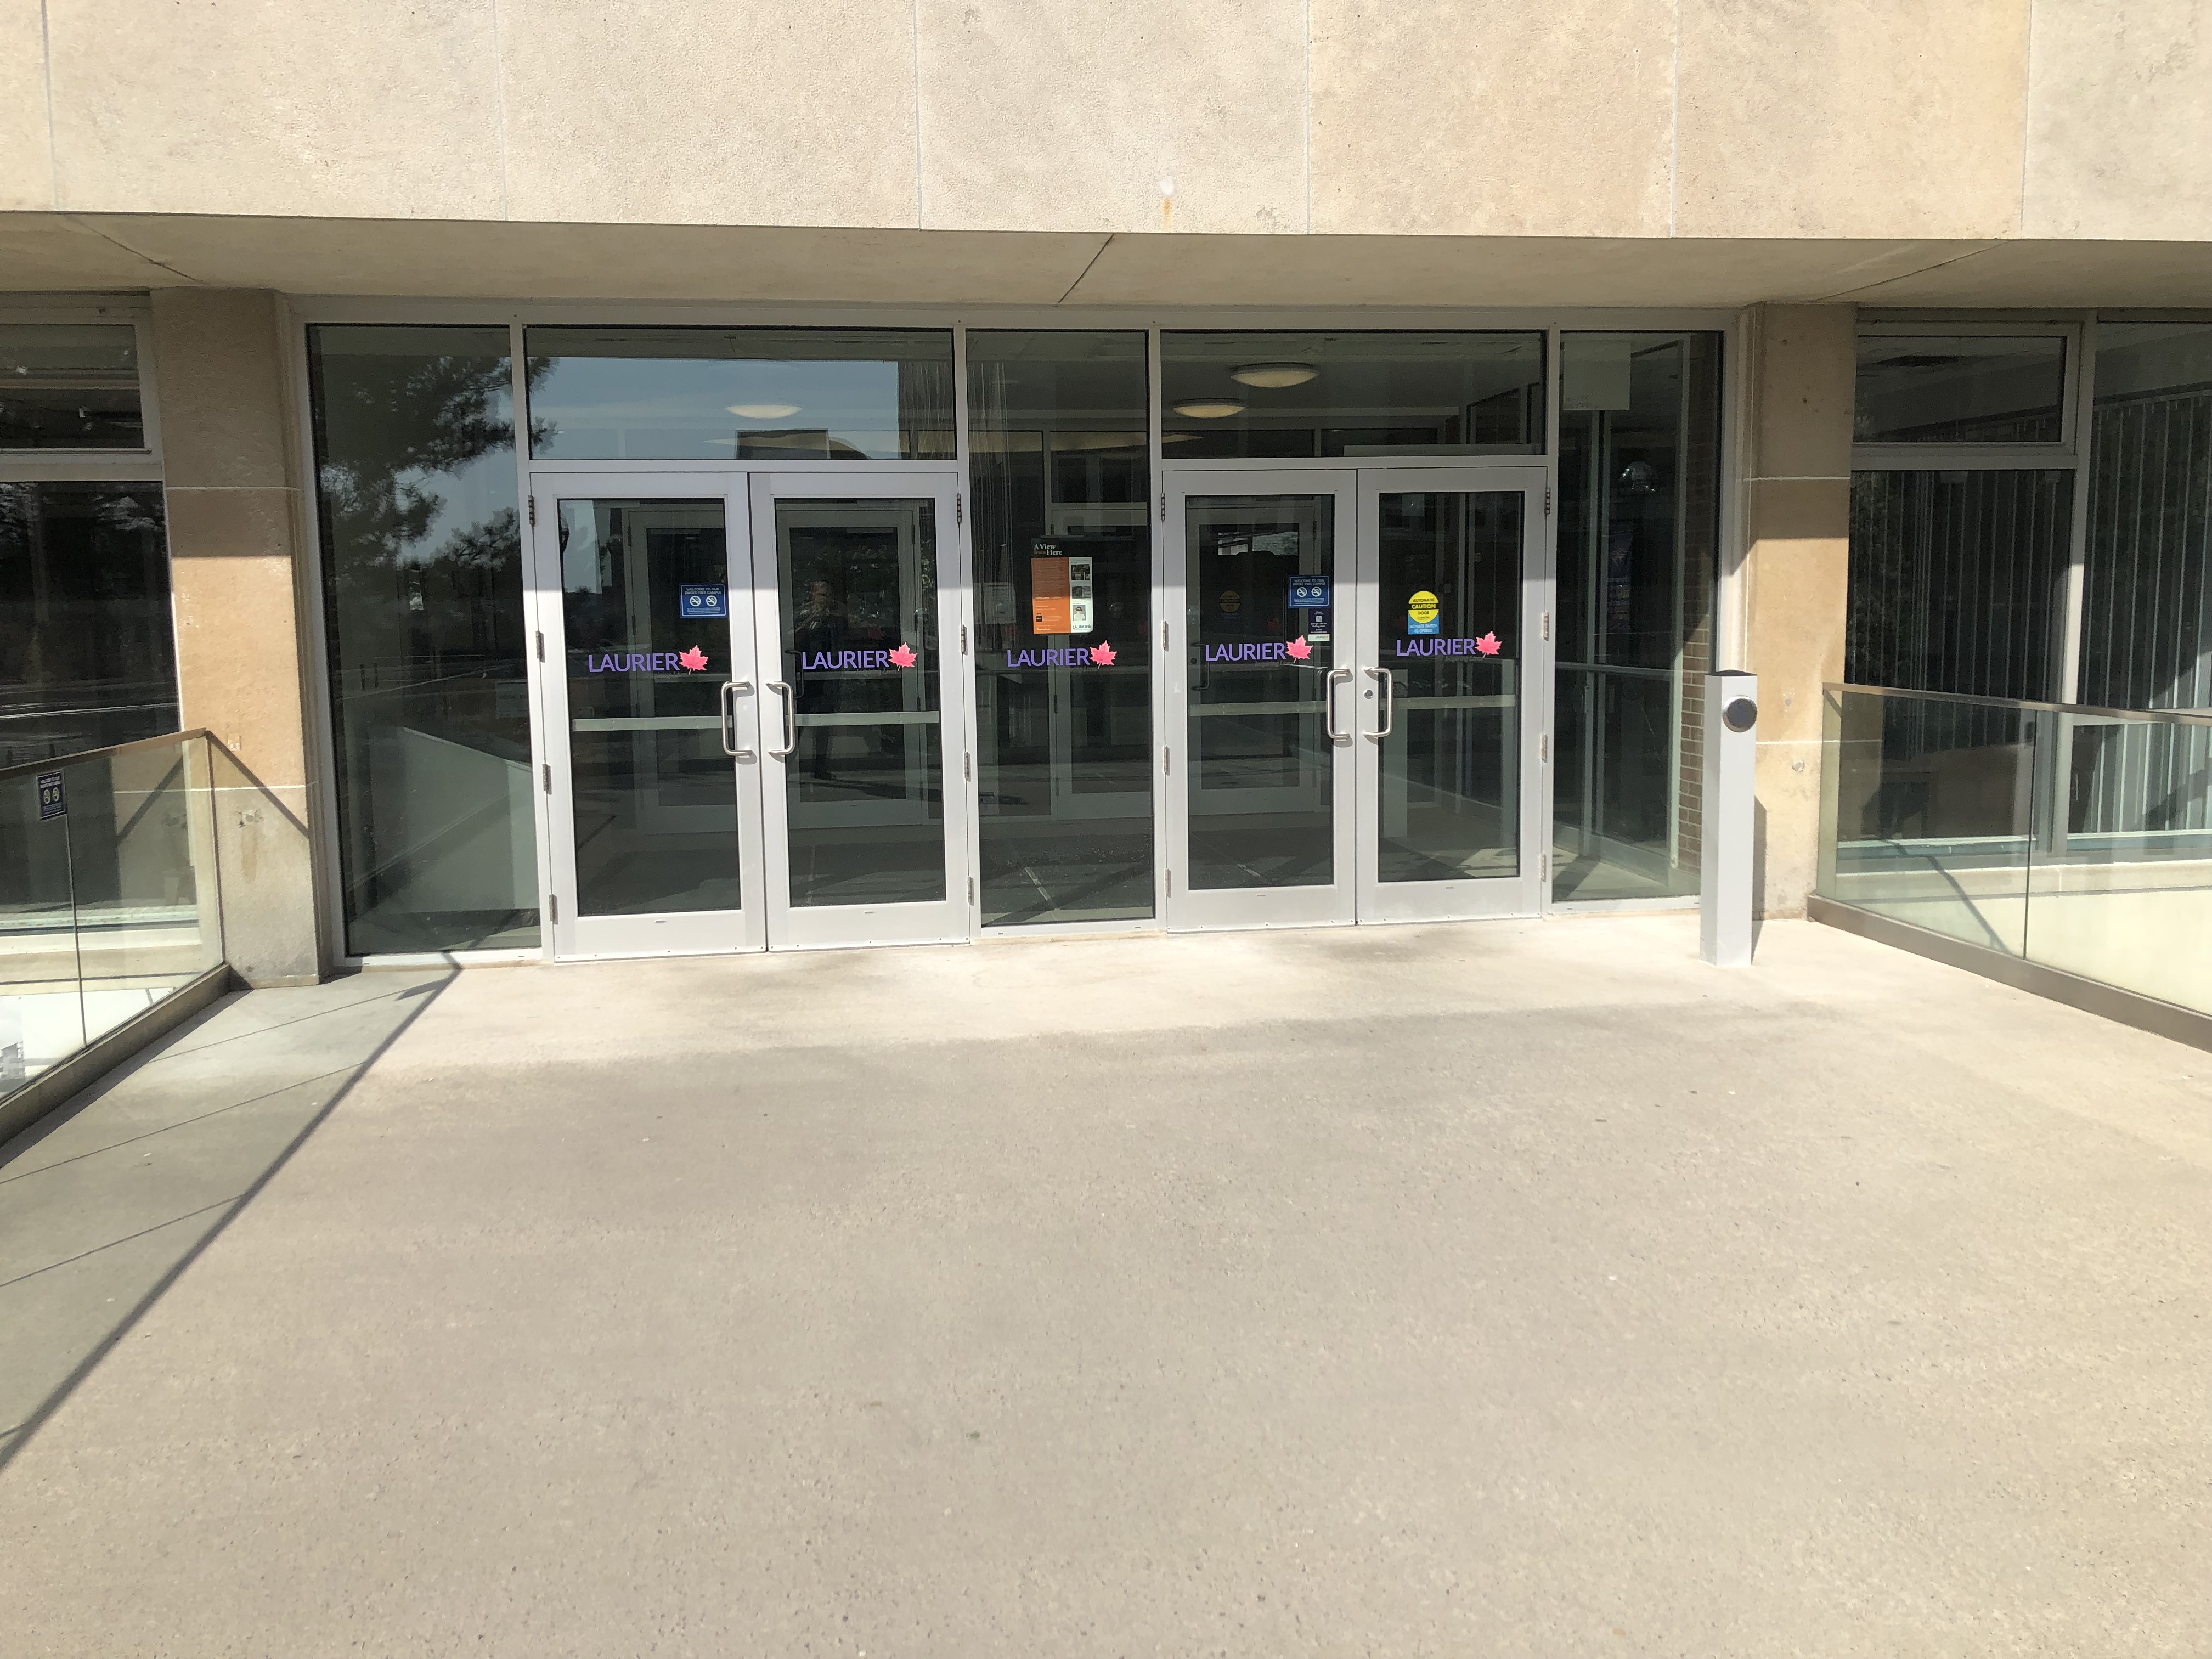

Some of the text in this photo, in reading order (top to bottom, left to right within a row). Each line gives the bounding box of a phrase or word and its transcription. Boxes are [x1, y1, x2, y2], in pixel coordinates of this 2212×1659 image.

[1205, 642, 1286, 662] LAURIER
[1397, 638, 1476, 656] LAURIER
[588, 653, 680, 673] LAURIER
[802, 650, 889, 669] LAURIER
[1007, 648, 1090, 667] LAURIER
